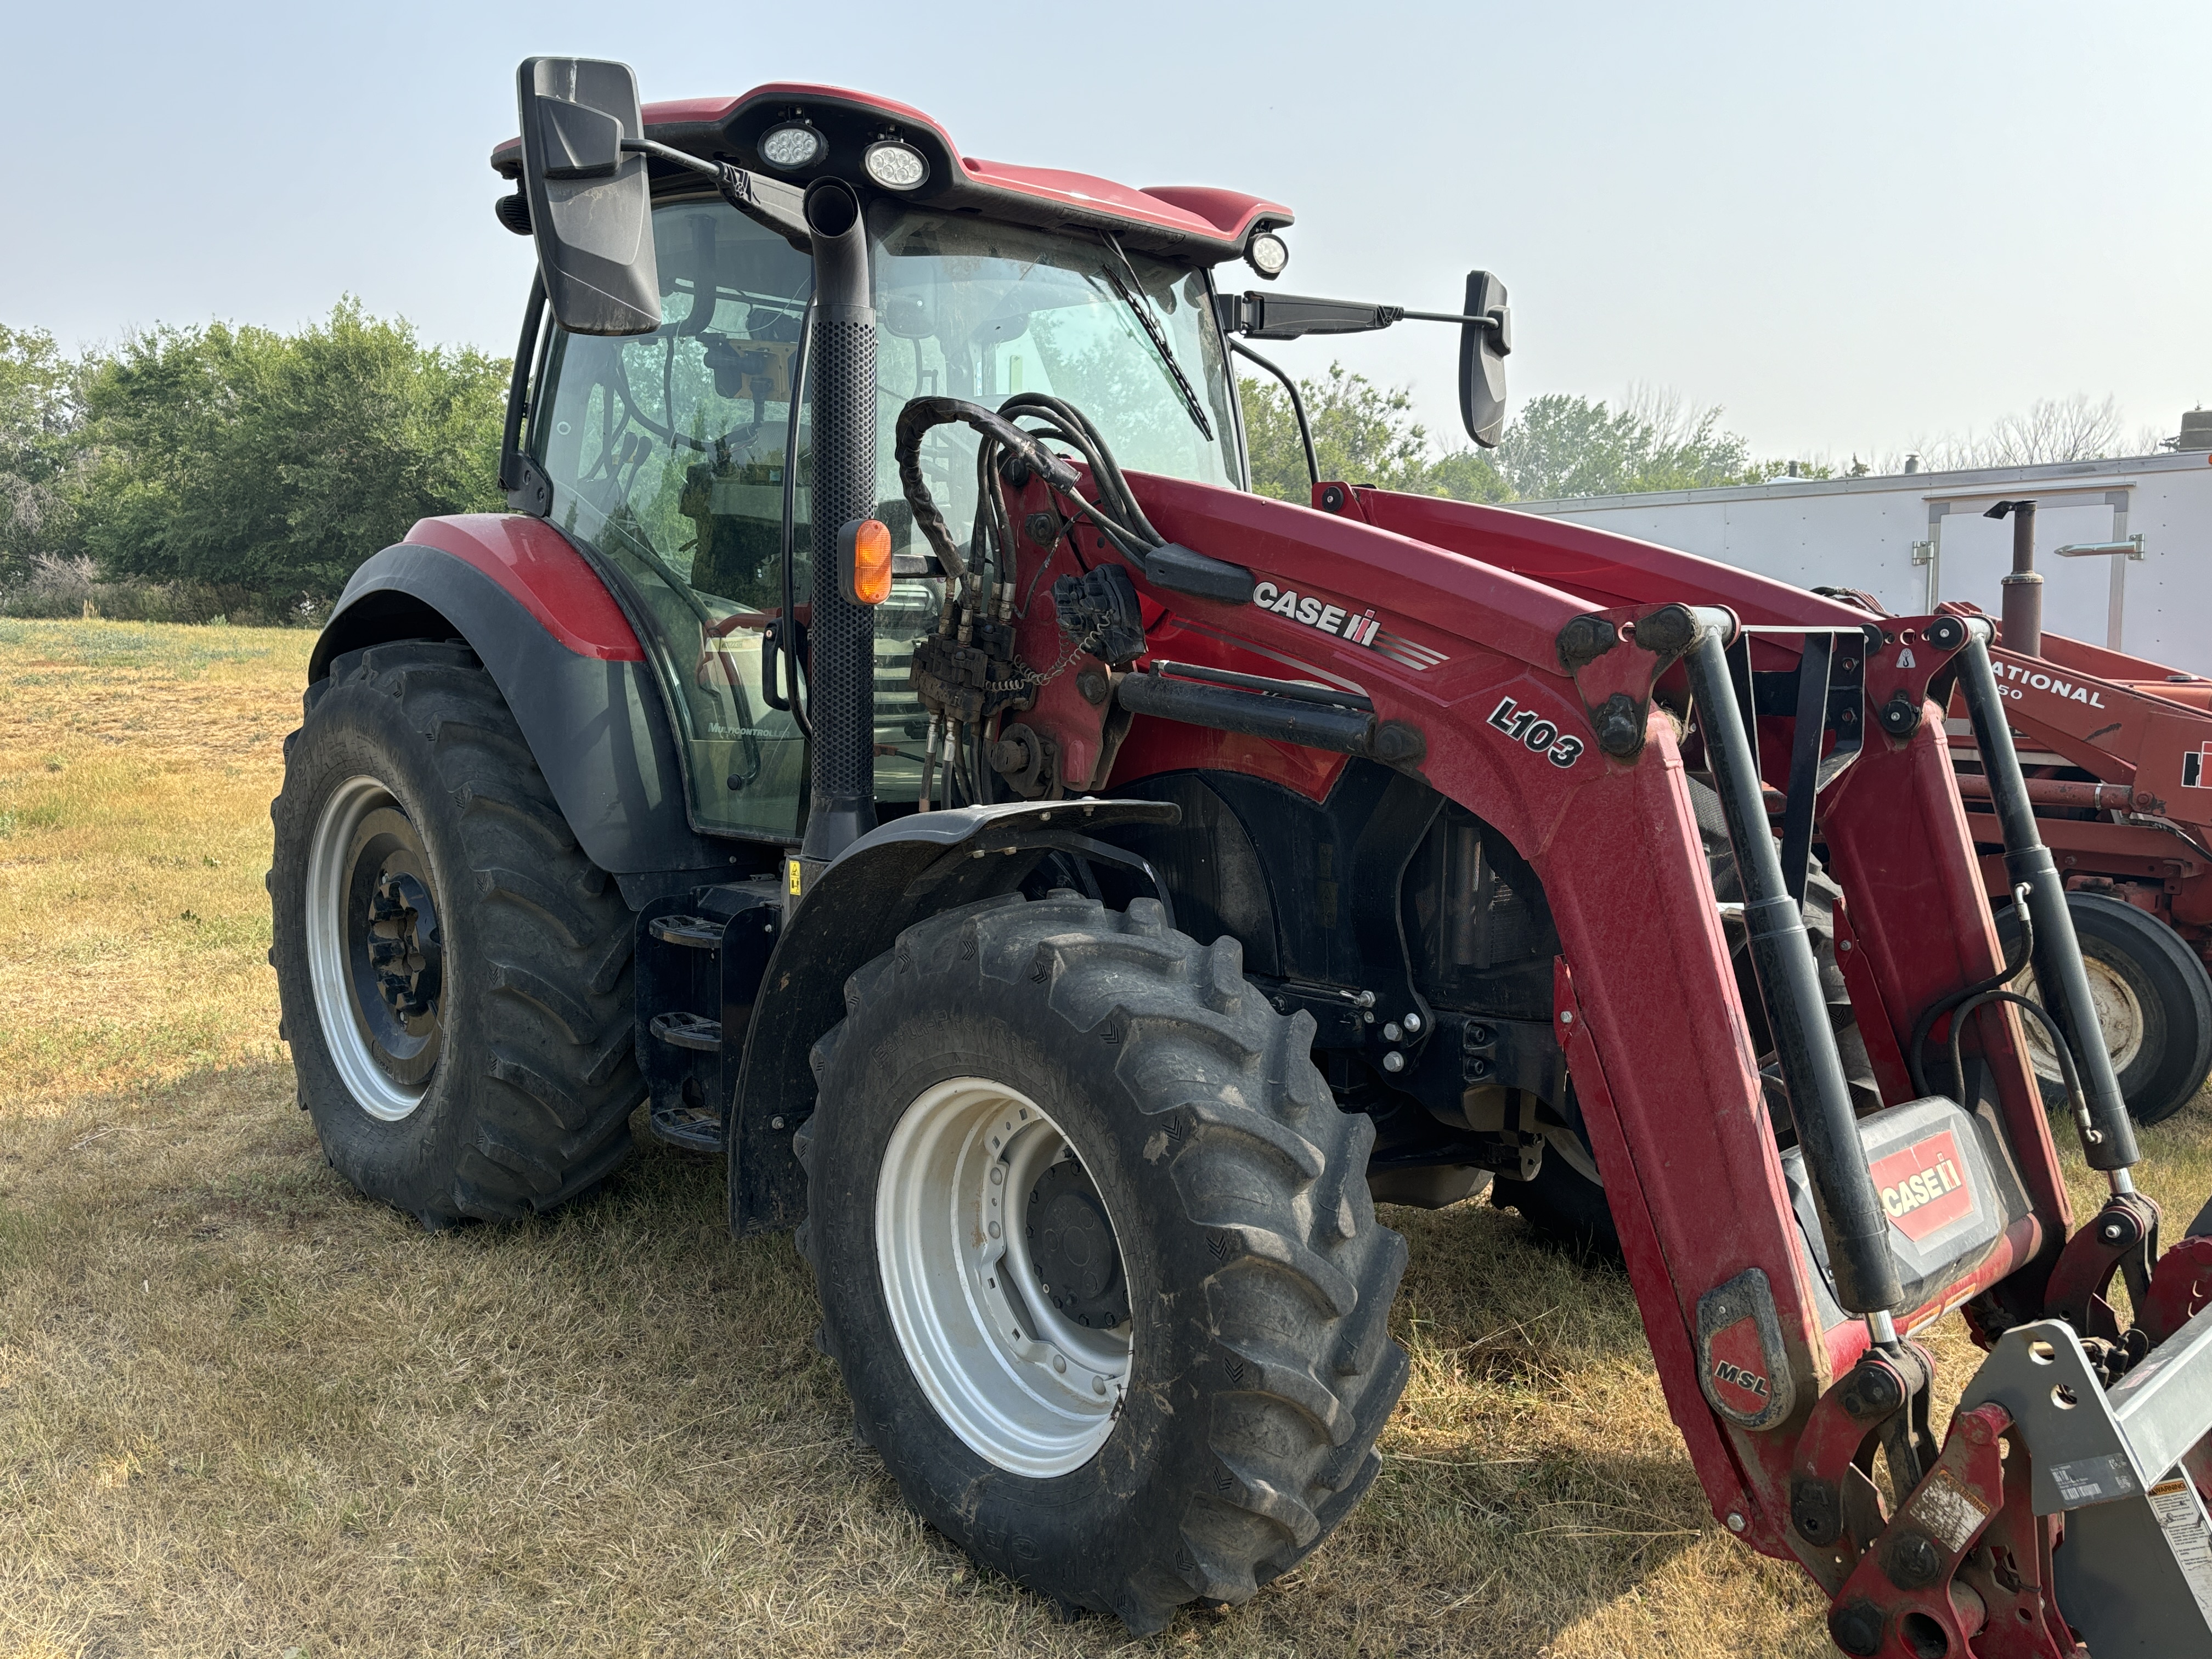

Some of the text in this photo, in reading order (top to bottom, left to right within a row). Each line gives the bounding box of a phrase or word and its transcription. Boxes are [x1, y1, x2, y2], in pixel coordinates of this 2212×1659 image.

[1253, 582, 1347, 635] CASE
[1486, 696, 1584, 769] L103
[1882, 1167, 1944, 1217] CASE
[1714, 1360, 1768, 1398] MSL
[2155, 1482, 2186, 1493] WARNING
